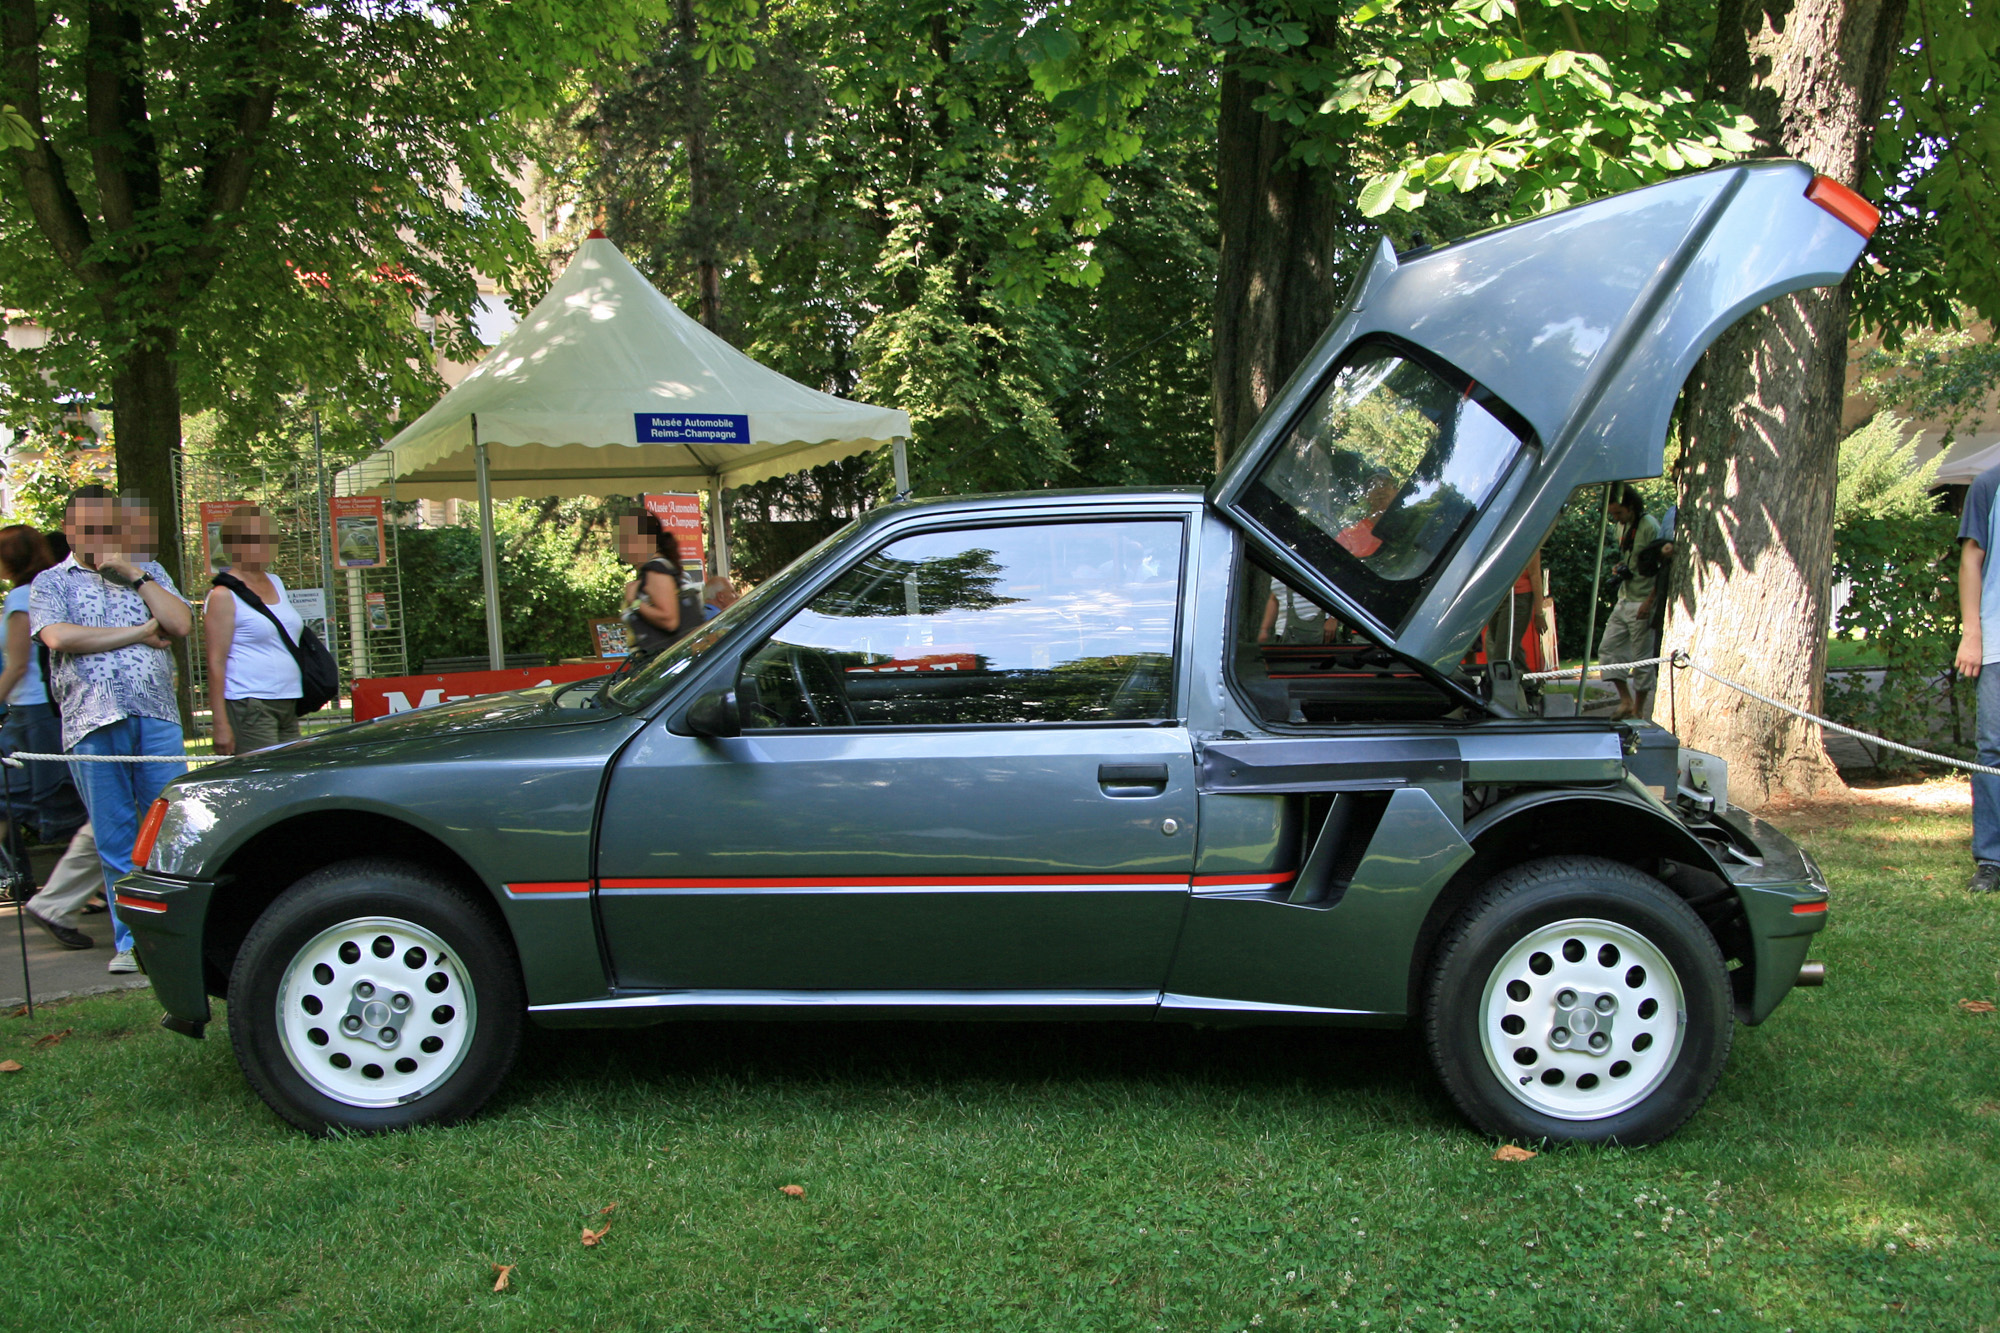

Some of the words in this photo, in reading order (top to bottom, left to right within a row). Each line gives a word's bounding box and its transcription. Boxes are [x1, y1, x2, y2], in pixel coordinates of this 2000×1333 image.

[651, 418, 682, 427] Musée
[685, 418, 734, 428] Automobile
[648, 501, 668, 513] Musée
[668, 501, 699, 514] Automobile
